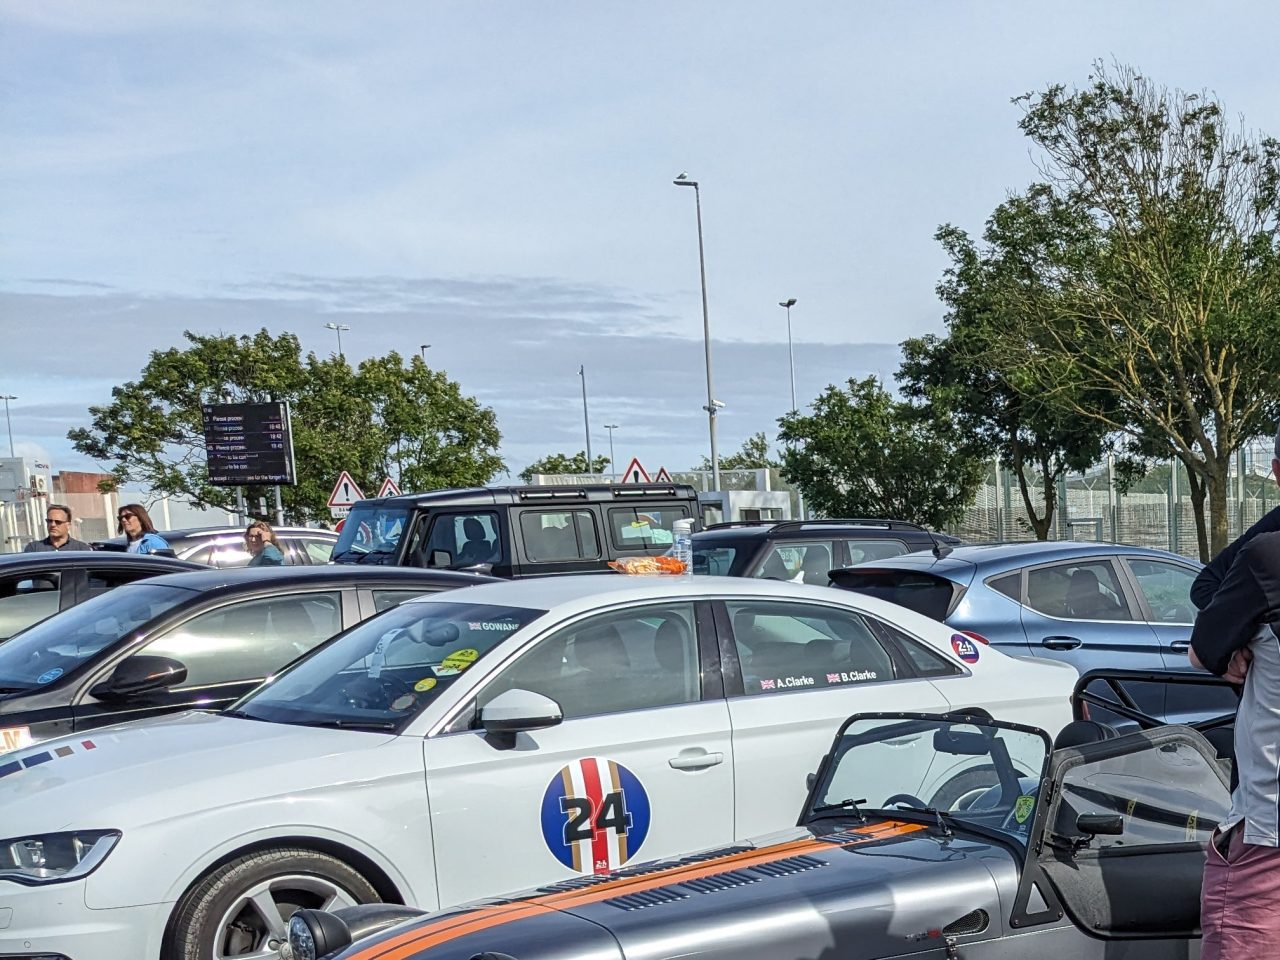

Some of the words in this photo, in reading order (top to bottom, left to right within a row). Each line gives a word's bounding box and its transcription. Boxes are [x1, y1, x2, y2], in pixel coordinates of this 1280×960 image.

[777, 676, 814, 689] A.Clarke
[841, 670, 877, 682] B.Clarke
[562, 790, 630, 843] 24
